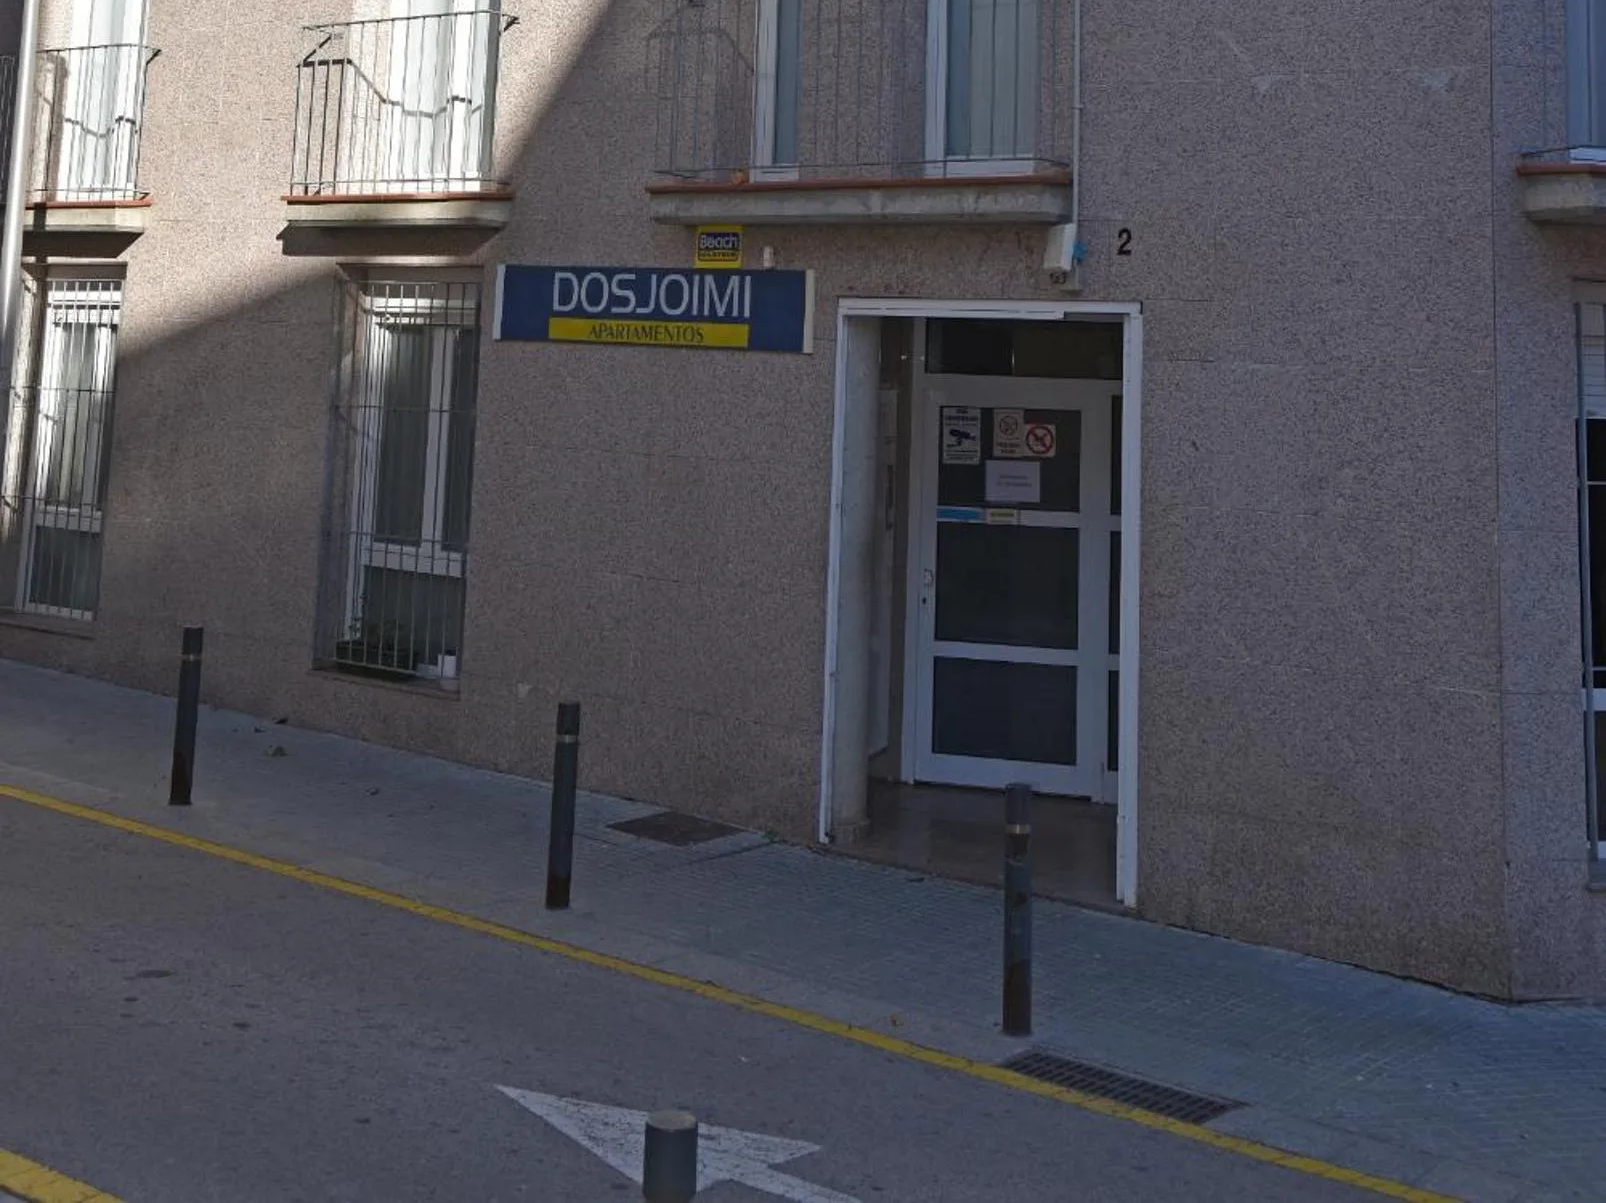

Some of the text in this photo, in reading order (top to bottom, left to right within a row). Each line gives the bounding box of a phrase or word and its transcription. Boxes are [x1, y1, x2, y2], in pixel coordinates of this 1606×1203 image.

[700, 234, 737, 249] Beach
[1117, 227, 1132, 256] 2
[588, 322, 705, 343] APARTAMENTOS
